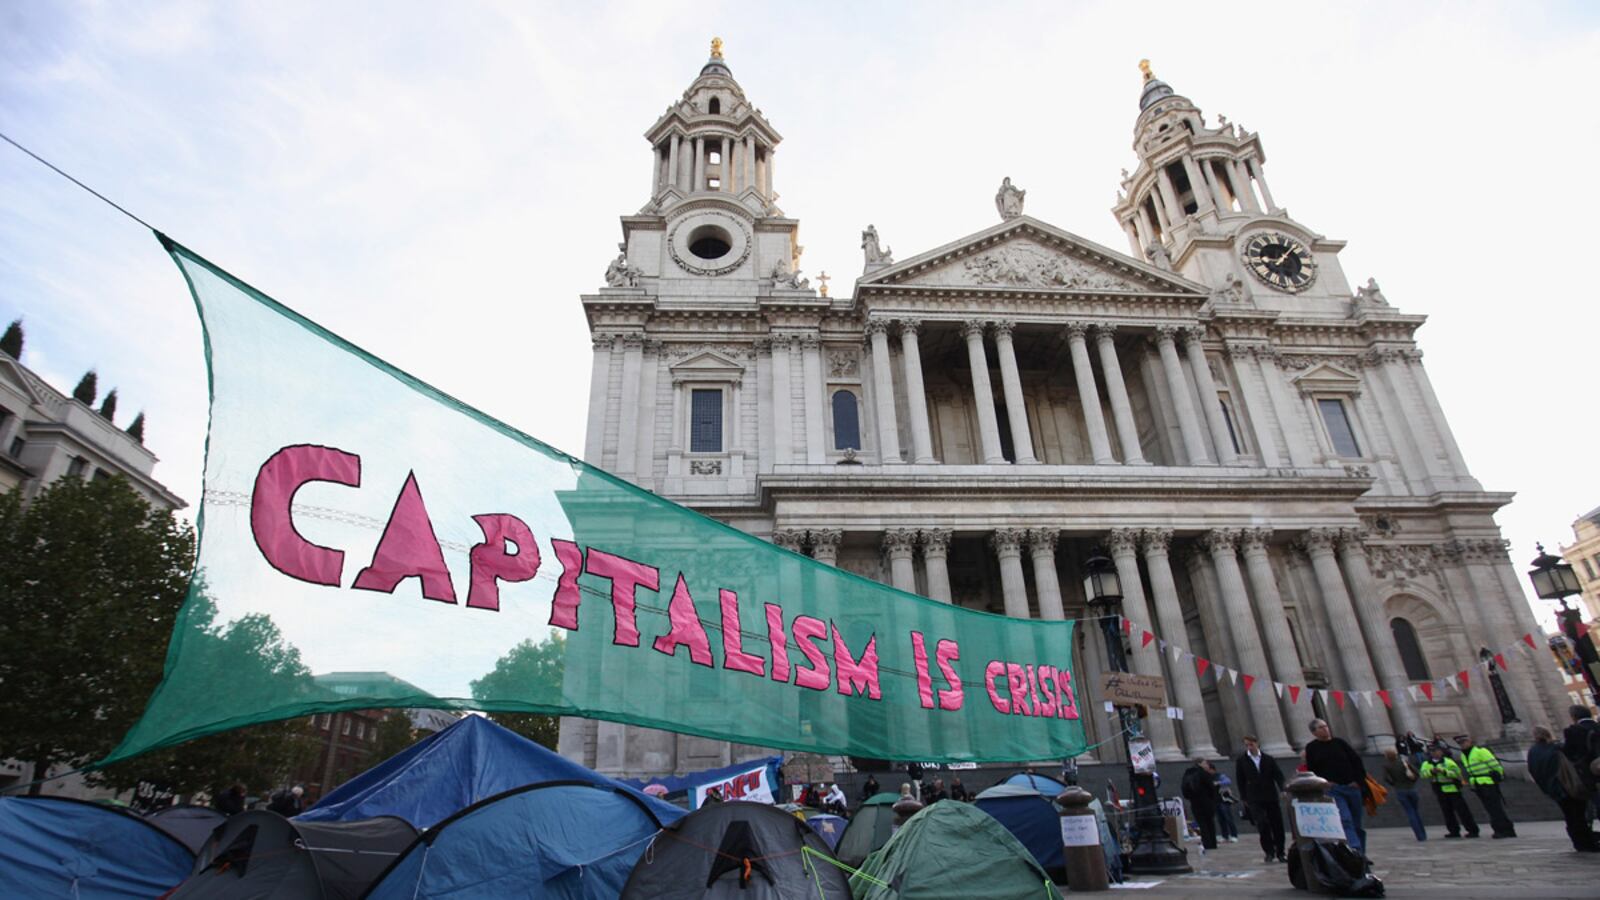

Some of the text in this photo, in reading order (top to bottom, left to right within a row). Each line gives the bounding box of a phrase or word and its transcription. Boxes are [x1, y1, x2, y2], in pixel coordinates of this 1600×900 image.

[251, 444, 1080, 720] CAPITALISM IS CRISIS
